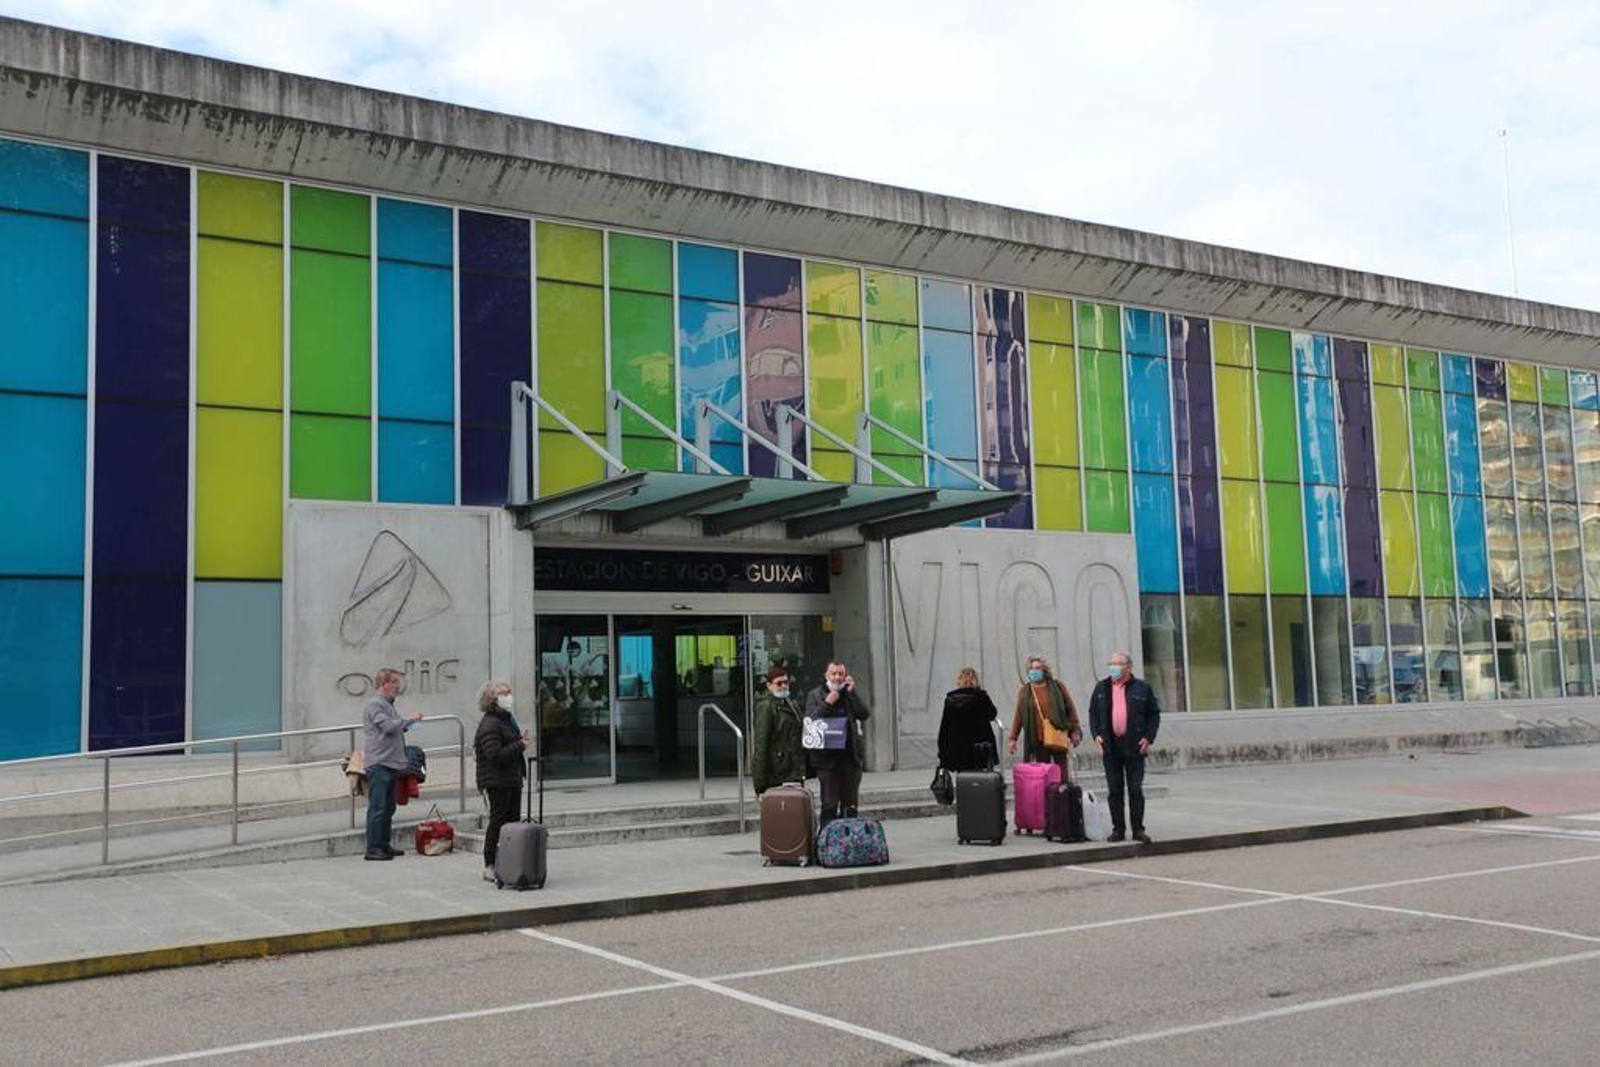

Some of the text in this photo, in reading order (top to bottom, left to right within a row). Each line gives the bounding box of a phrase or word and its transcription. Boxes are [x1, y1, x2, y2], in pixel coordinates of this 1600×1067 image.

[642, 561, 671, 581] DE
[673, 562, 726, 583] VIGO
[746, 563, 813, 584] GUIXAR
[893, 561, 1132, 712] VIGO
